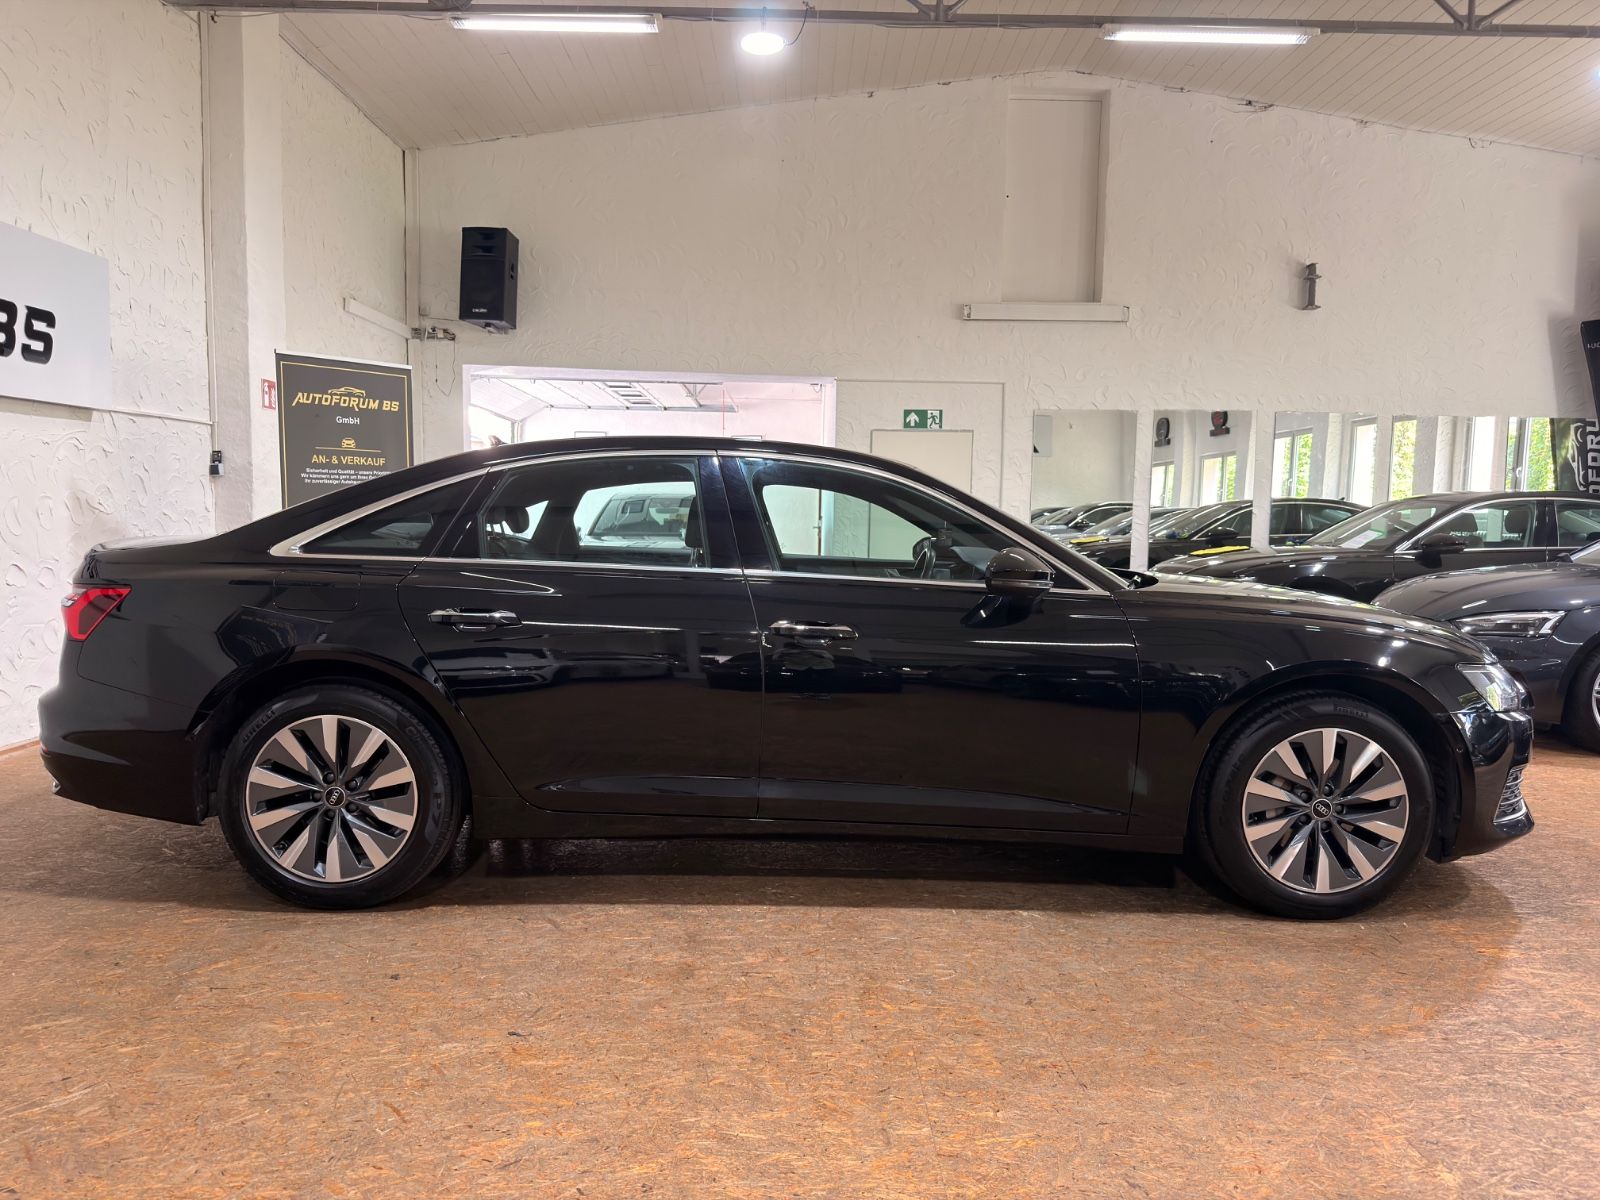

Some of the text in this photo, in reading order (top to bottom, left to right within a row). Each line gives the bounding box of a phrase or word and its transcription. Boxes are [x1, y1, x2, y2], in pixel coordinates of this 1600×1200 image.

[292, 392, 400, 411] AUTOFORUM BS
[336, 416, 360, 424] GmbH
[311, 455, 386, 466] AN- & VERKAUF
